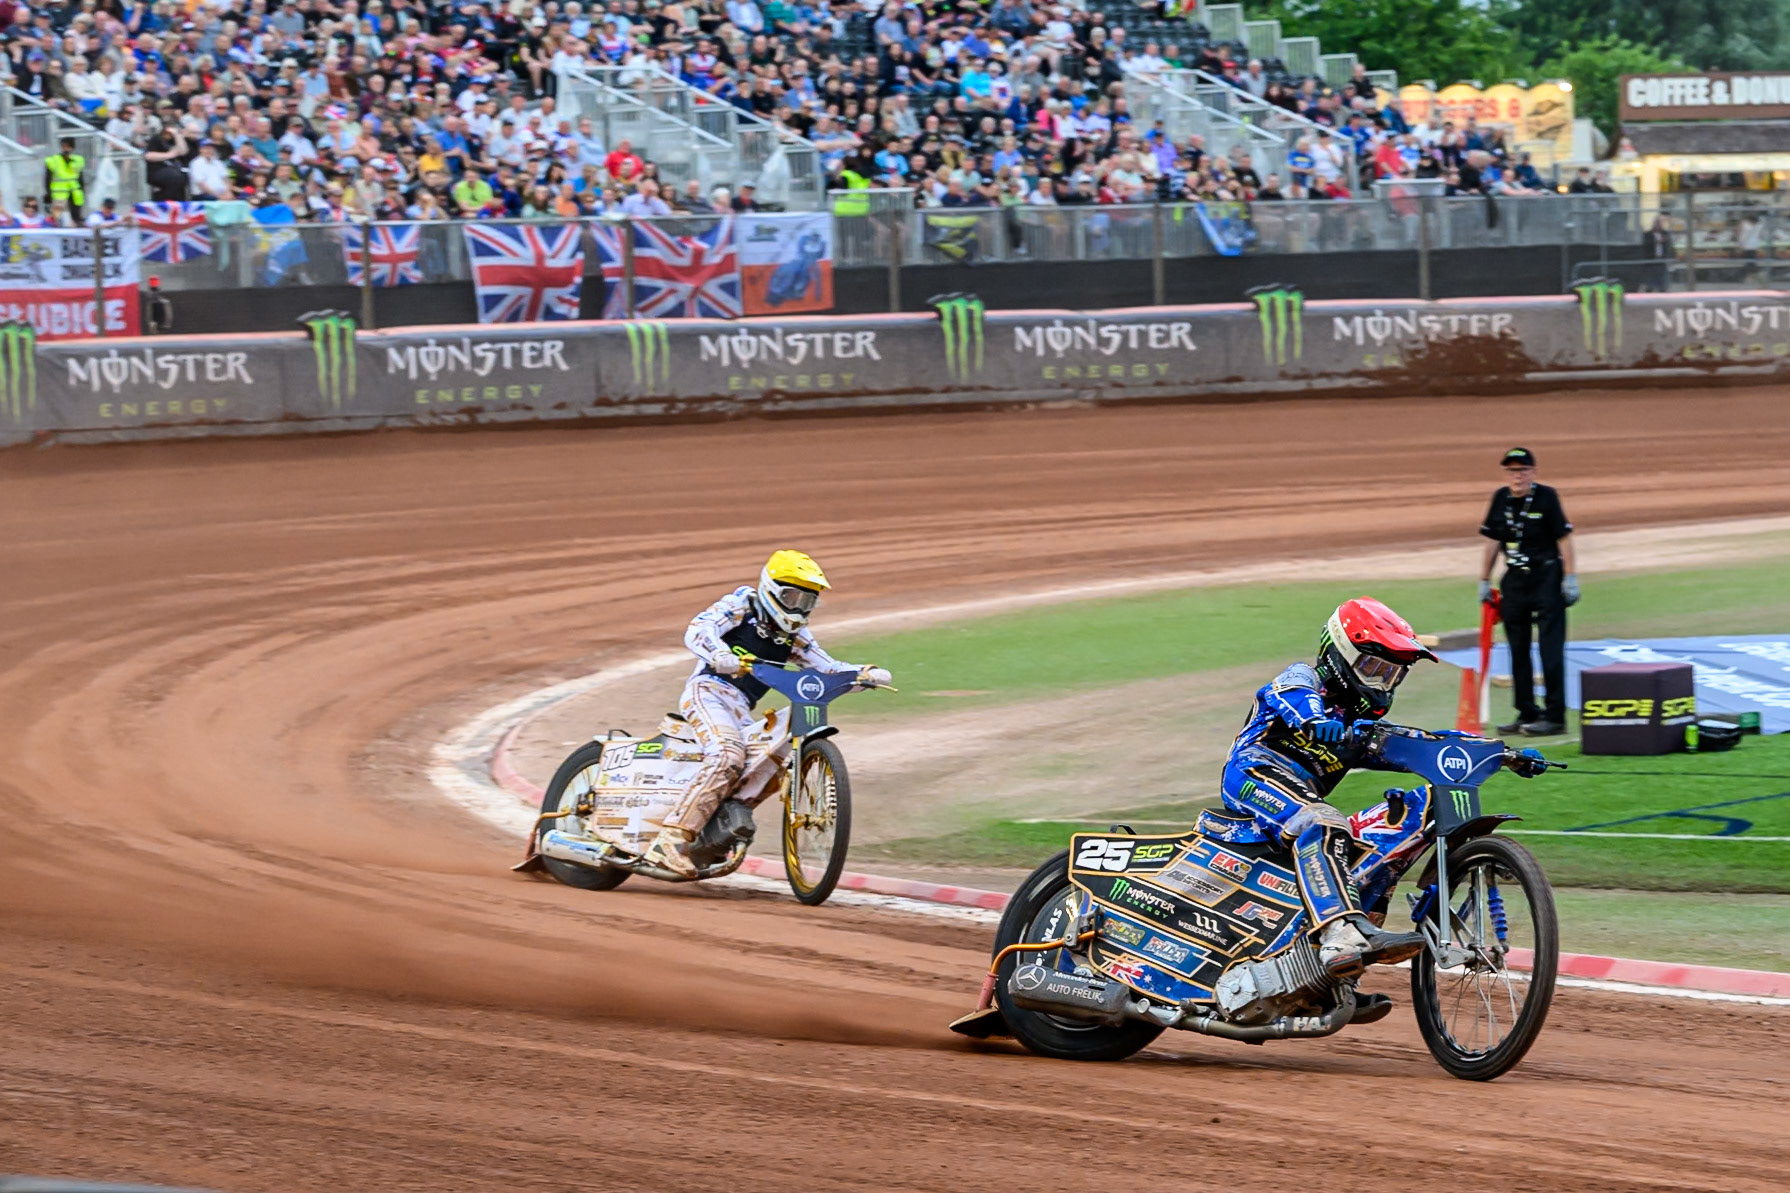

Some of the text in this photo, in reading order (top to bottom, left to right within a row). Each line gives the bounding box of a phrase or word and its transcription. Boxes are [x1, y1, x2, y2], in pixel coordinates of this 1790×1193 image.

[1628, 77, 1710, 107] COFFEE
[1711, 80, 1730, 105] &
[1654, 300, 1790, 338] MONST
[699, 327, 882, 368] MONSTER
[1014, 318, 1197, 357] MONSTER
[66, 348, 253, 393] MONSTER
[387, 338, 570, 382] MONSTER
[1043, 361, 1170, 380] ENERGY
[416, 384, 543, 404] ENERGY
[99, 398, 228, 418] ENERGY
[602, 743, 638, 772] 105
[1443, 758, 1467, 771] ATPI
[1075, 839, 1136, 871] 25
[1133, 843, 1174, 860] SGP
[1212, 852, 1239, 871] EK
[1126, 886, 1176, 914] MONSTER
[1126, 898, 1168, 919] ENERGY
[1053, 971, 1108, 987] Mercedes-Benz
[1047, 982, 1103, 1002] AUTO FRELIK
